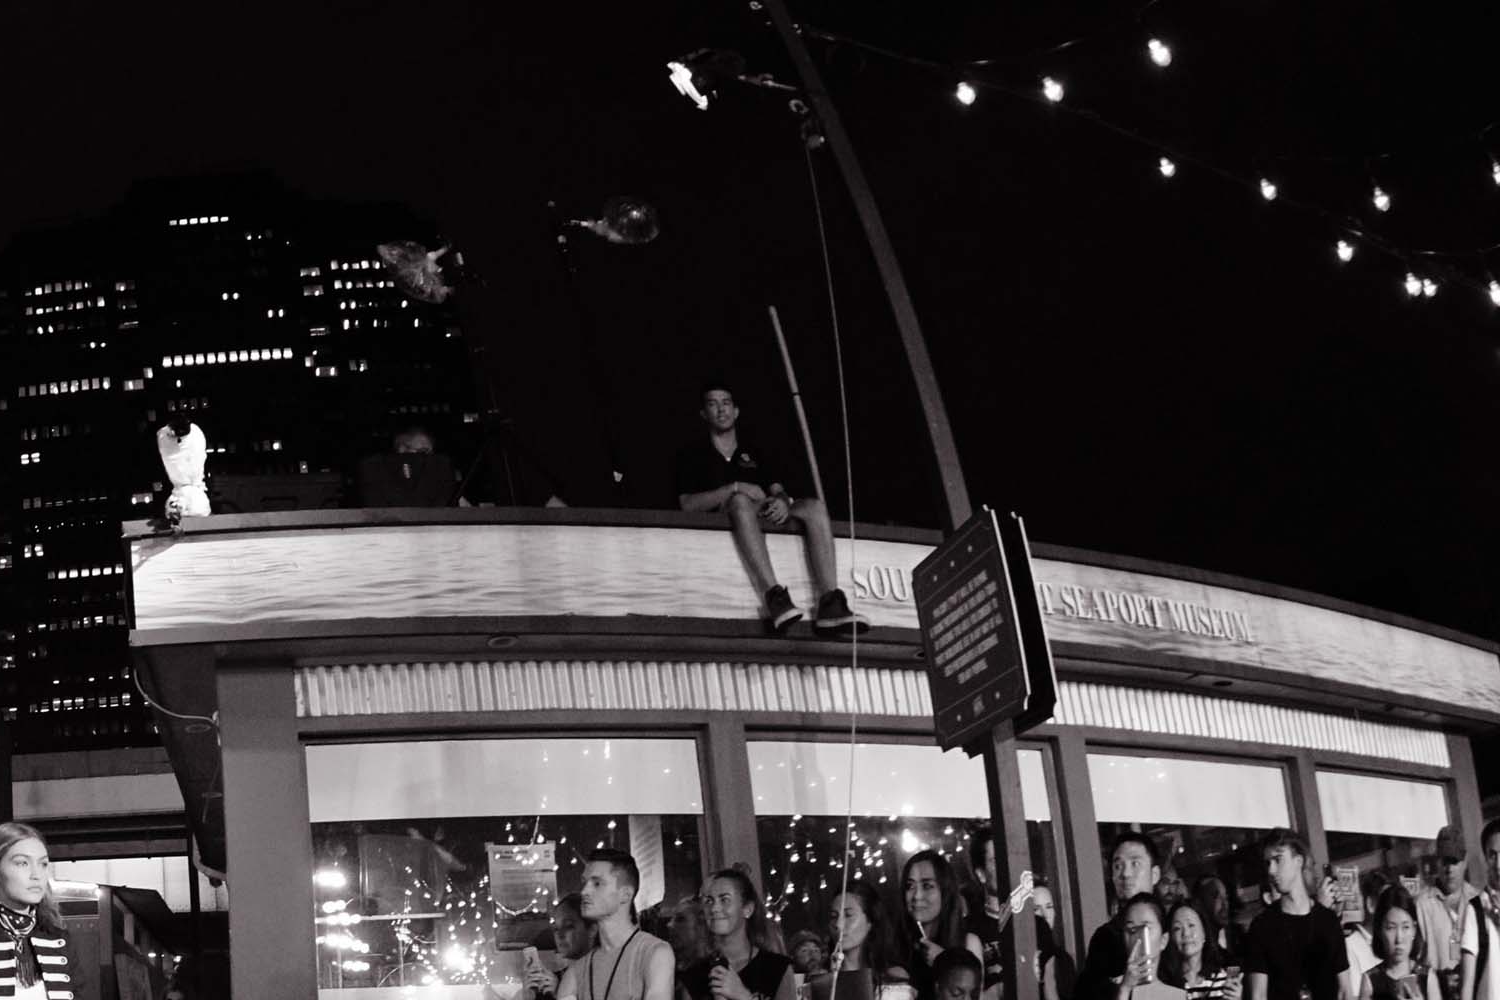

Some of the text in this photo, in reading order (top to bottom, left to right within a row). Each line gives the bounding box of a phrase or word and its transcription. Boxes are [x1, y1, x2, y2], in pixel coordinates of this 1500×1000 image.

[853, 565, 910, 602] SOU
[1060, 583, 1166, 630] SEAPORT
[1172, 600, 1256, 642] MUSEUM
